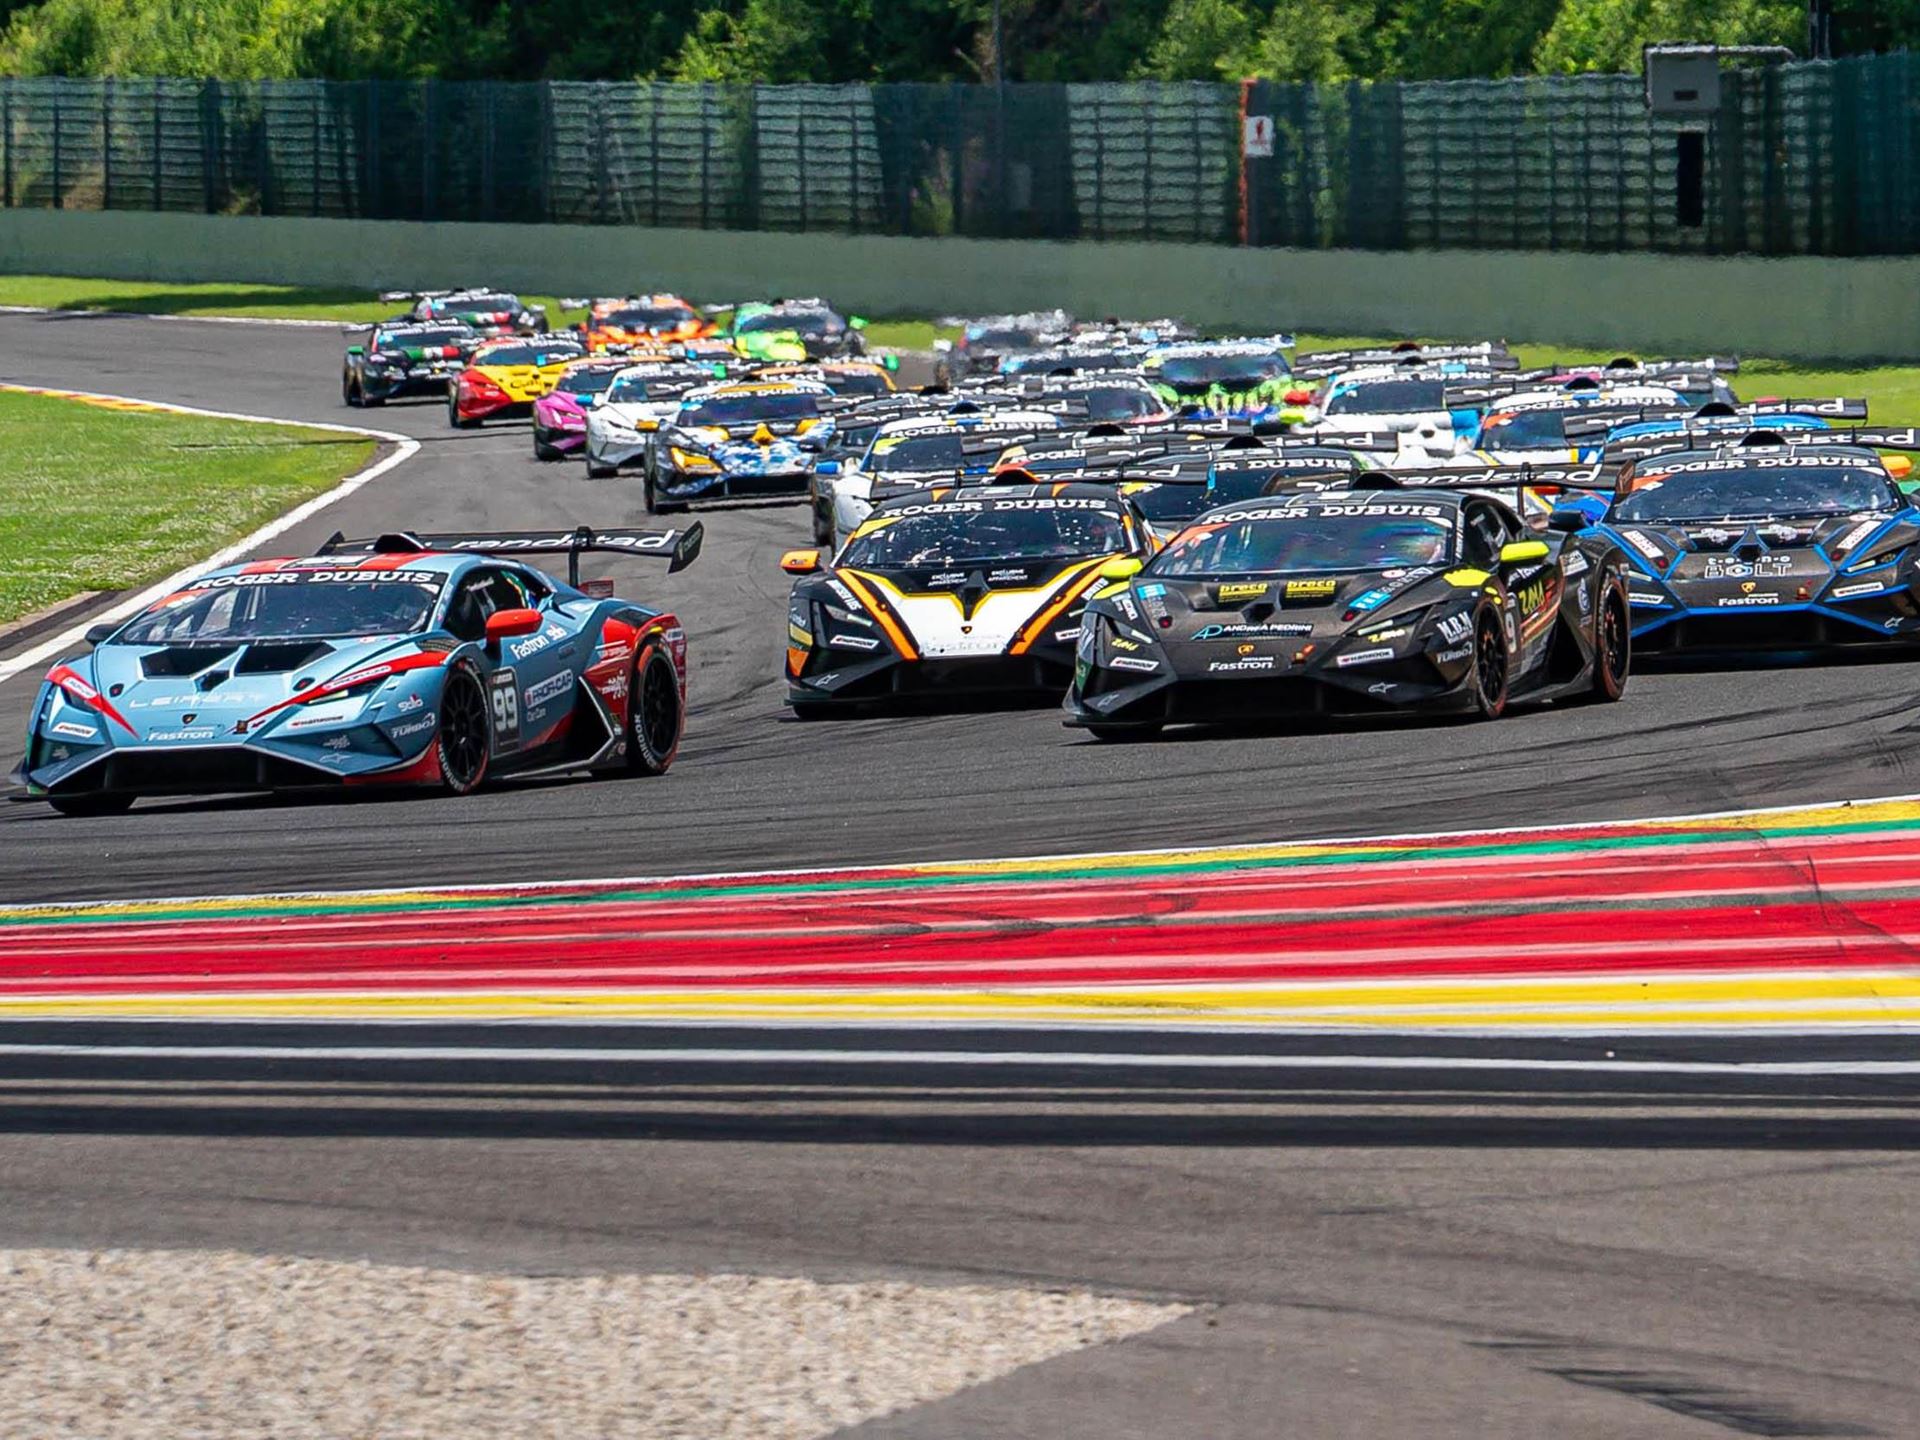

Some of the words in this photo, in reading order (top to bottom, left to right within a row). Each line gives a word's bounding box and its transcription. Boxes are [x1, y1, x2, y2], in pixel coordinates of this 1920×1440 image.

[1709, 429, 1915, 449] radstad
[1644, 459, 1747, 477] ROGER
[1757, 457, 1871, 468] DUBUIS
[882, 501, 983, 518] ROGER
[993, 499, 1107, 511] DUBUIS
[1202, 506, 1309, 525] ROGER
[1319, 504, 1442, 517] DUBUIS
[188, 572, 300, 591] ROGER
[307, 570, 435, 584] DUBUIS
[1718, 597, 1779, 607] Fastron
[509, 634, 550, 660] Fastron
[1208, 661, 1274, 672] Fastron
[492, 686, 519, 732] 99
[148, 730, 214, 742] Fastron
